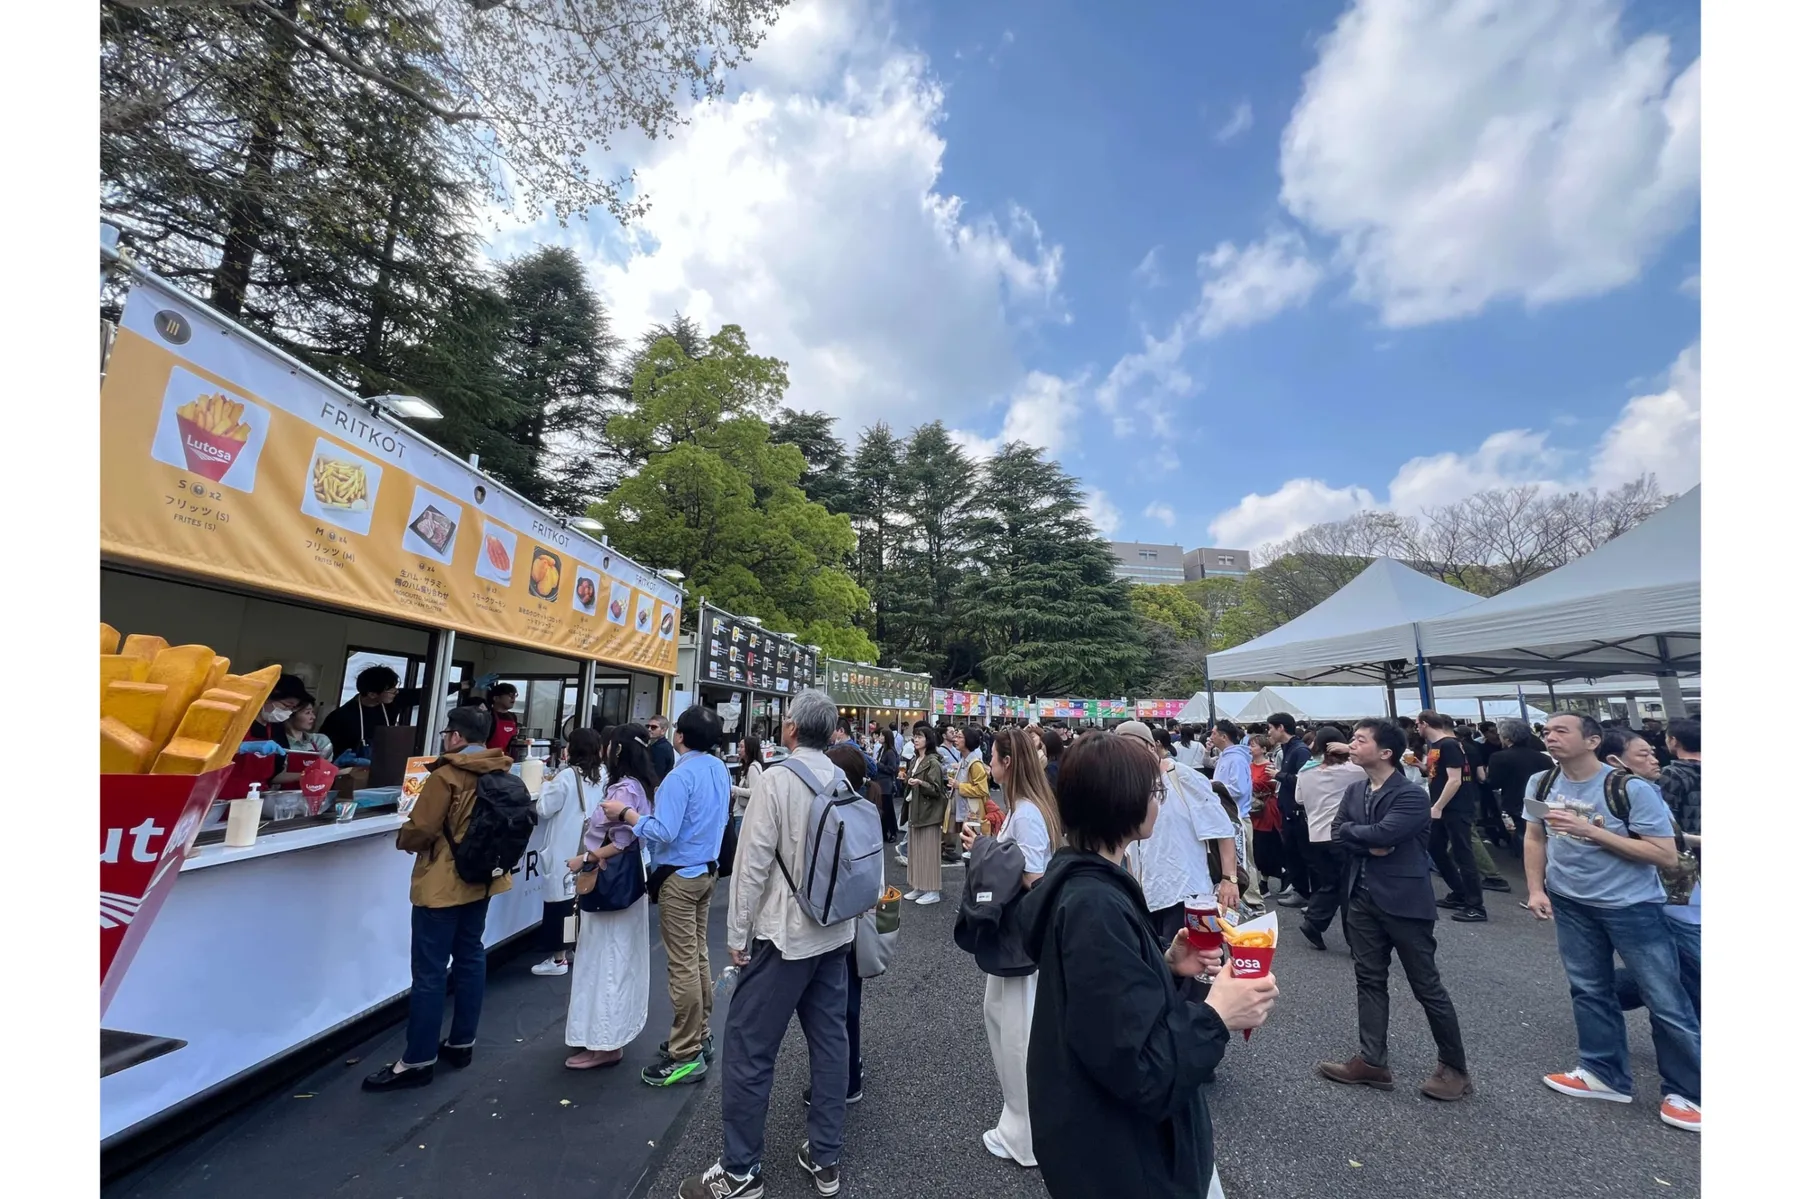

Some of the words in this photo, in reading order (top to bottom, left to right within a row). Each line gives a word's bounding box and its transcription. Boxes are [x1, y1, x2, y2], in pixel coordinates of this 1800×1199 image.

[321, 402, 406, 458] FRITKOT
[187, 434, 231, 461] Lutosa
[178, 479, 187, 489] S
[209, 491, 222, 501] x2
[165, 495, 212, 516] フリッツ
[216, 511, 230, 523] (S)
[173, 513, 202, 527] FRITES
[204, 522, 216, 532] (S)
[315, 527, 324, 536] M
[532, 520, 570, 548] FRITKOT
[305, 540, 340, 556] フリッツ
